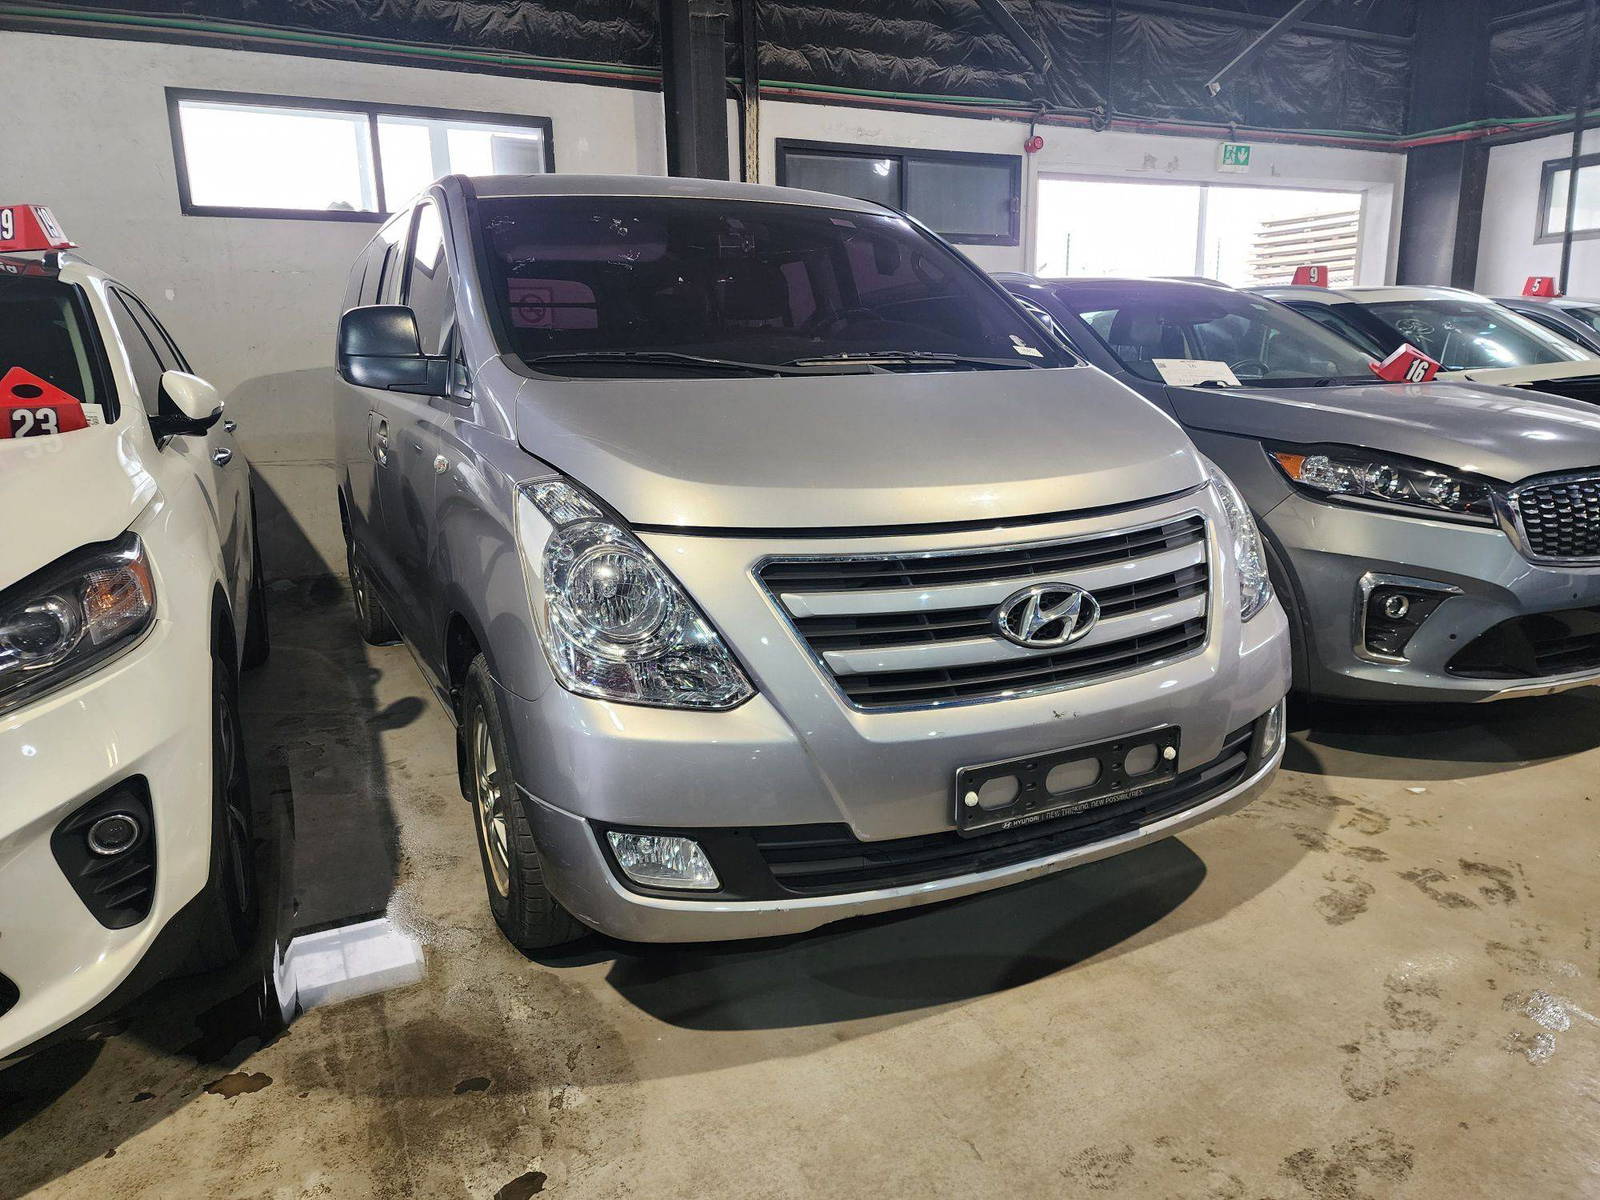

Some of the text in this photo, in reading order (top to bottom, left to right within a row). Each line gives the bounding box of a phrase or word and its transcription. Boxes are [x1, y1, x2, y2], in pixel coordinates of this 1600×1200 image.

[0, 209, 13, 240] 9
[1310, 267, 1318, 283] 9
[1532, 278, 1542, 292] 5
[1406, 358, 1429, 383] 16
[12, 408, 58, 438] 23
[1013, 815, 1040, 826] HYUNDAI
[1091, 800, 1105, 808] NEW
